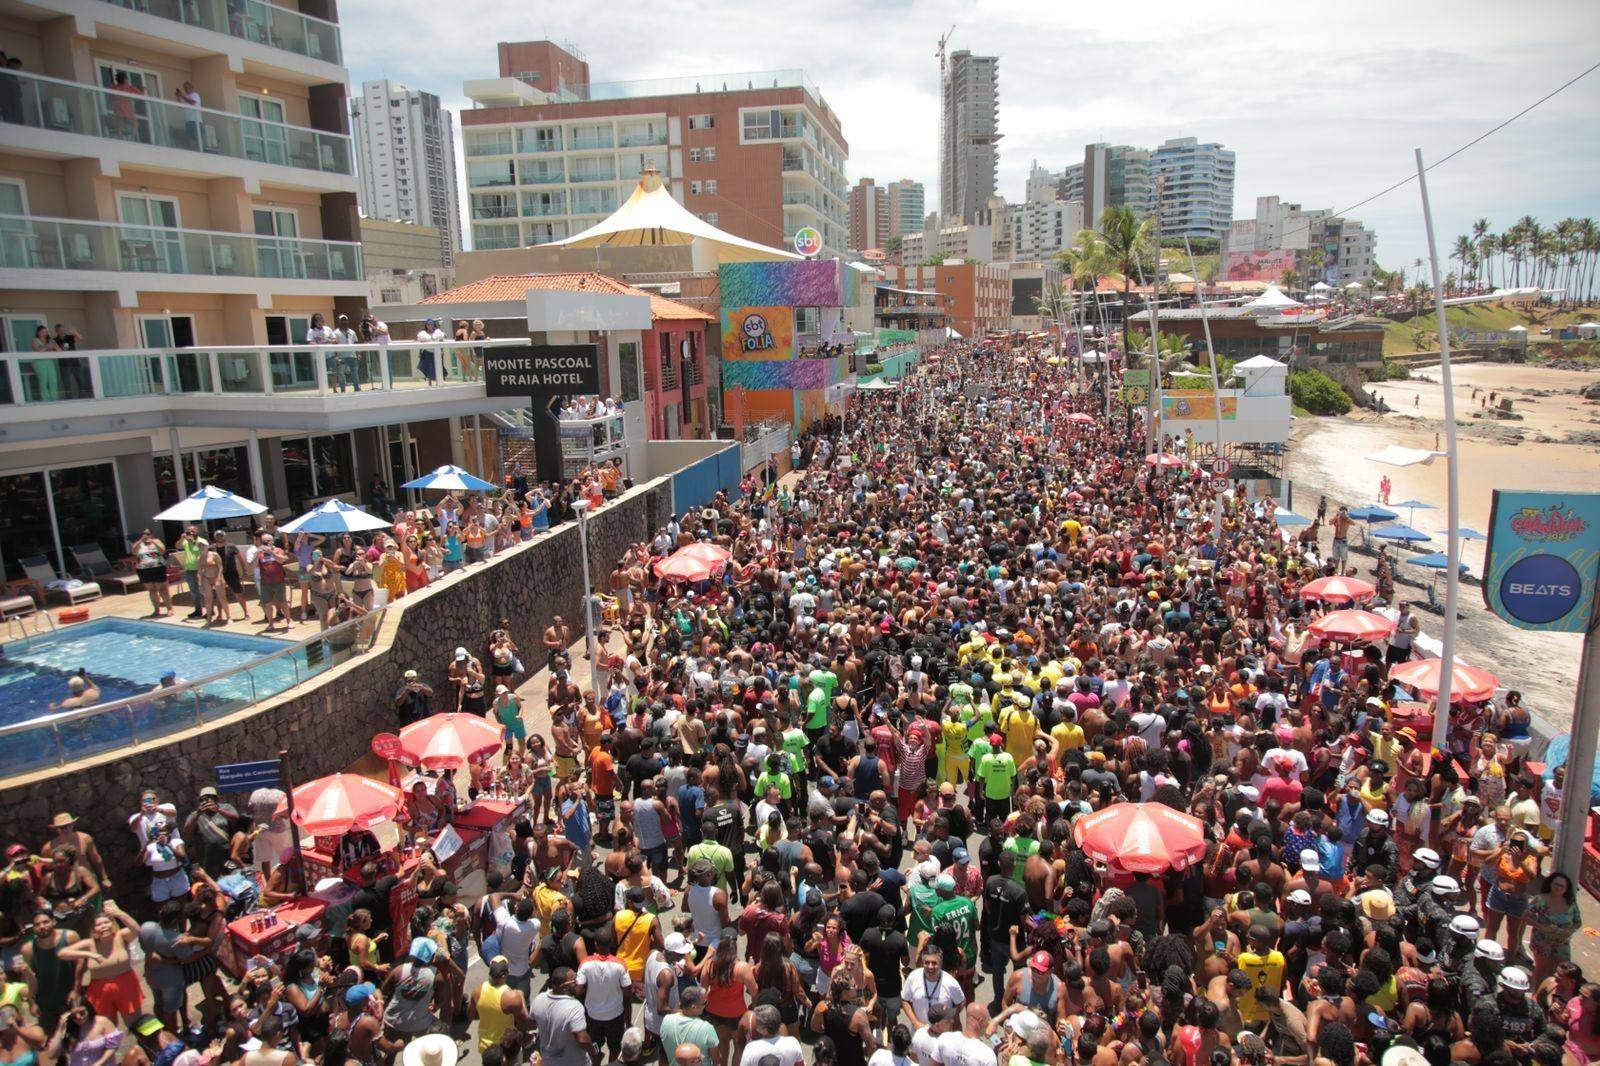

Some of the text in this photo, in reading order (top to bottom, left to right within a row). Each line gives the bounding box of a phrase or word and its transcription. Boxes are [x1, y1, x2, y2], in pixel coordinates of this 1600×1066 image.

[797, 233, 818, 248] sbt
[745, 320, 764, 331] sbt
[741, 333, 775, 353] FOLIA
[487, 357, 592, 370] MONTE PASCOAL
[501, 373, 583, 385] PRAIA HOTEL
[1214, 479, 1227, 488] 30
[1509, 583, 1572, 597] BEATS
[952, 916, 970, 940] 92
[1502, 1020, 1526, 1032] 2193
